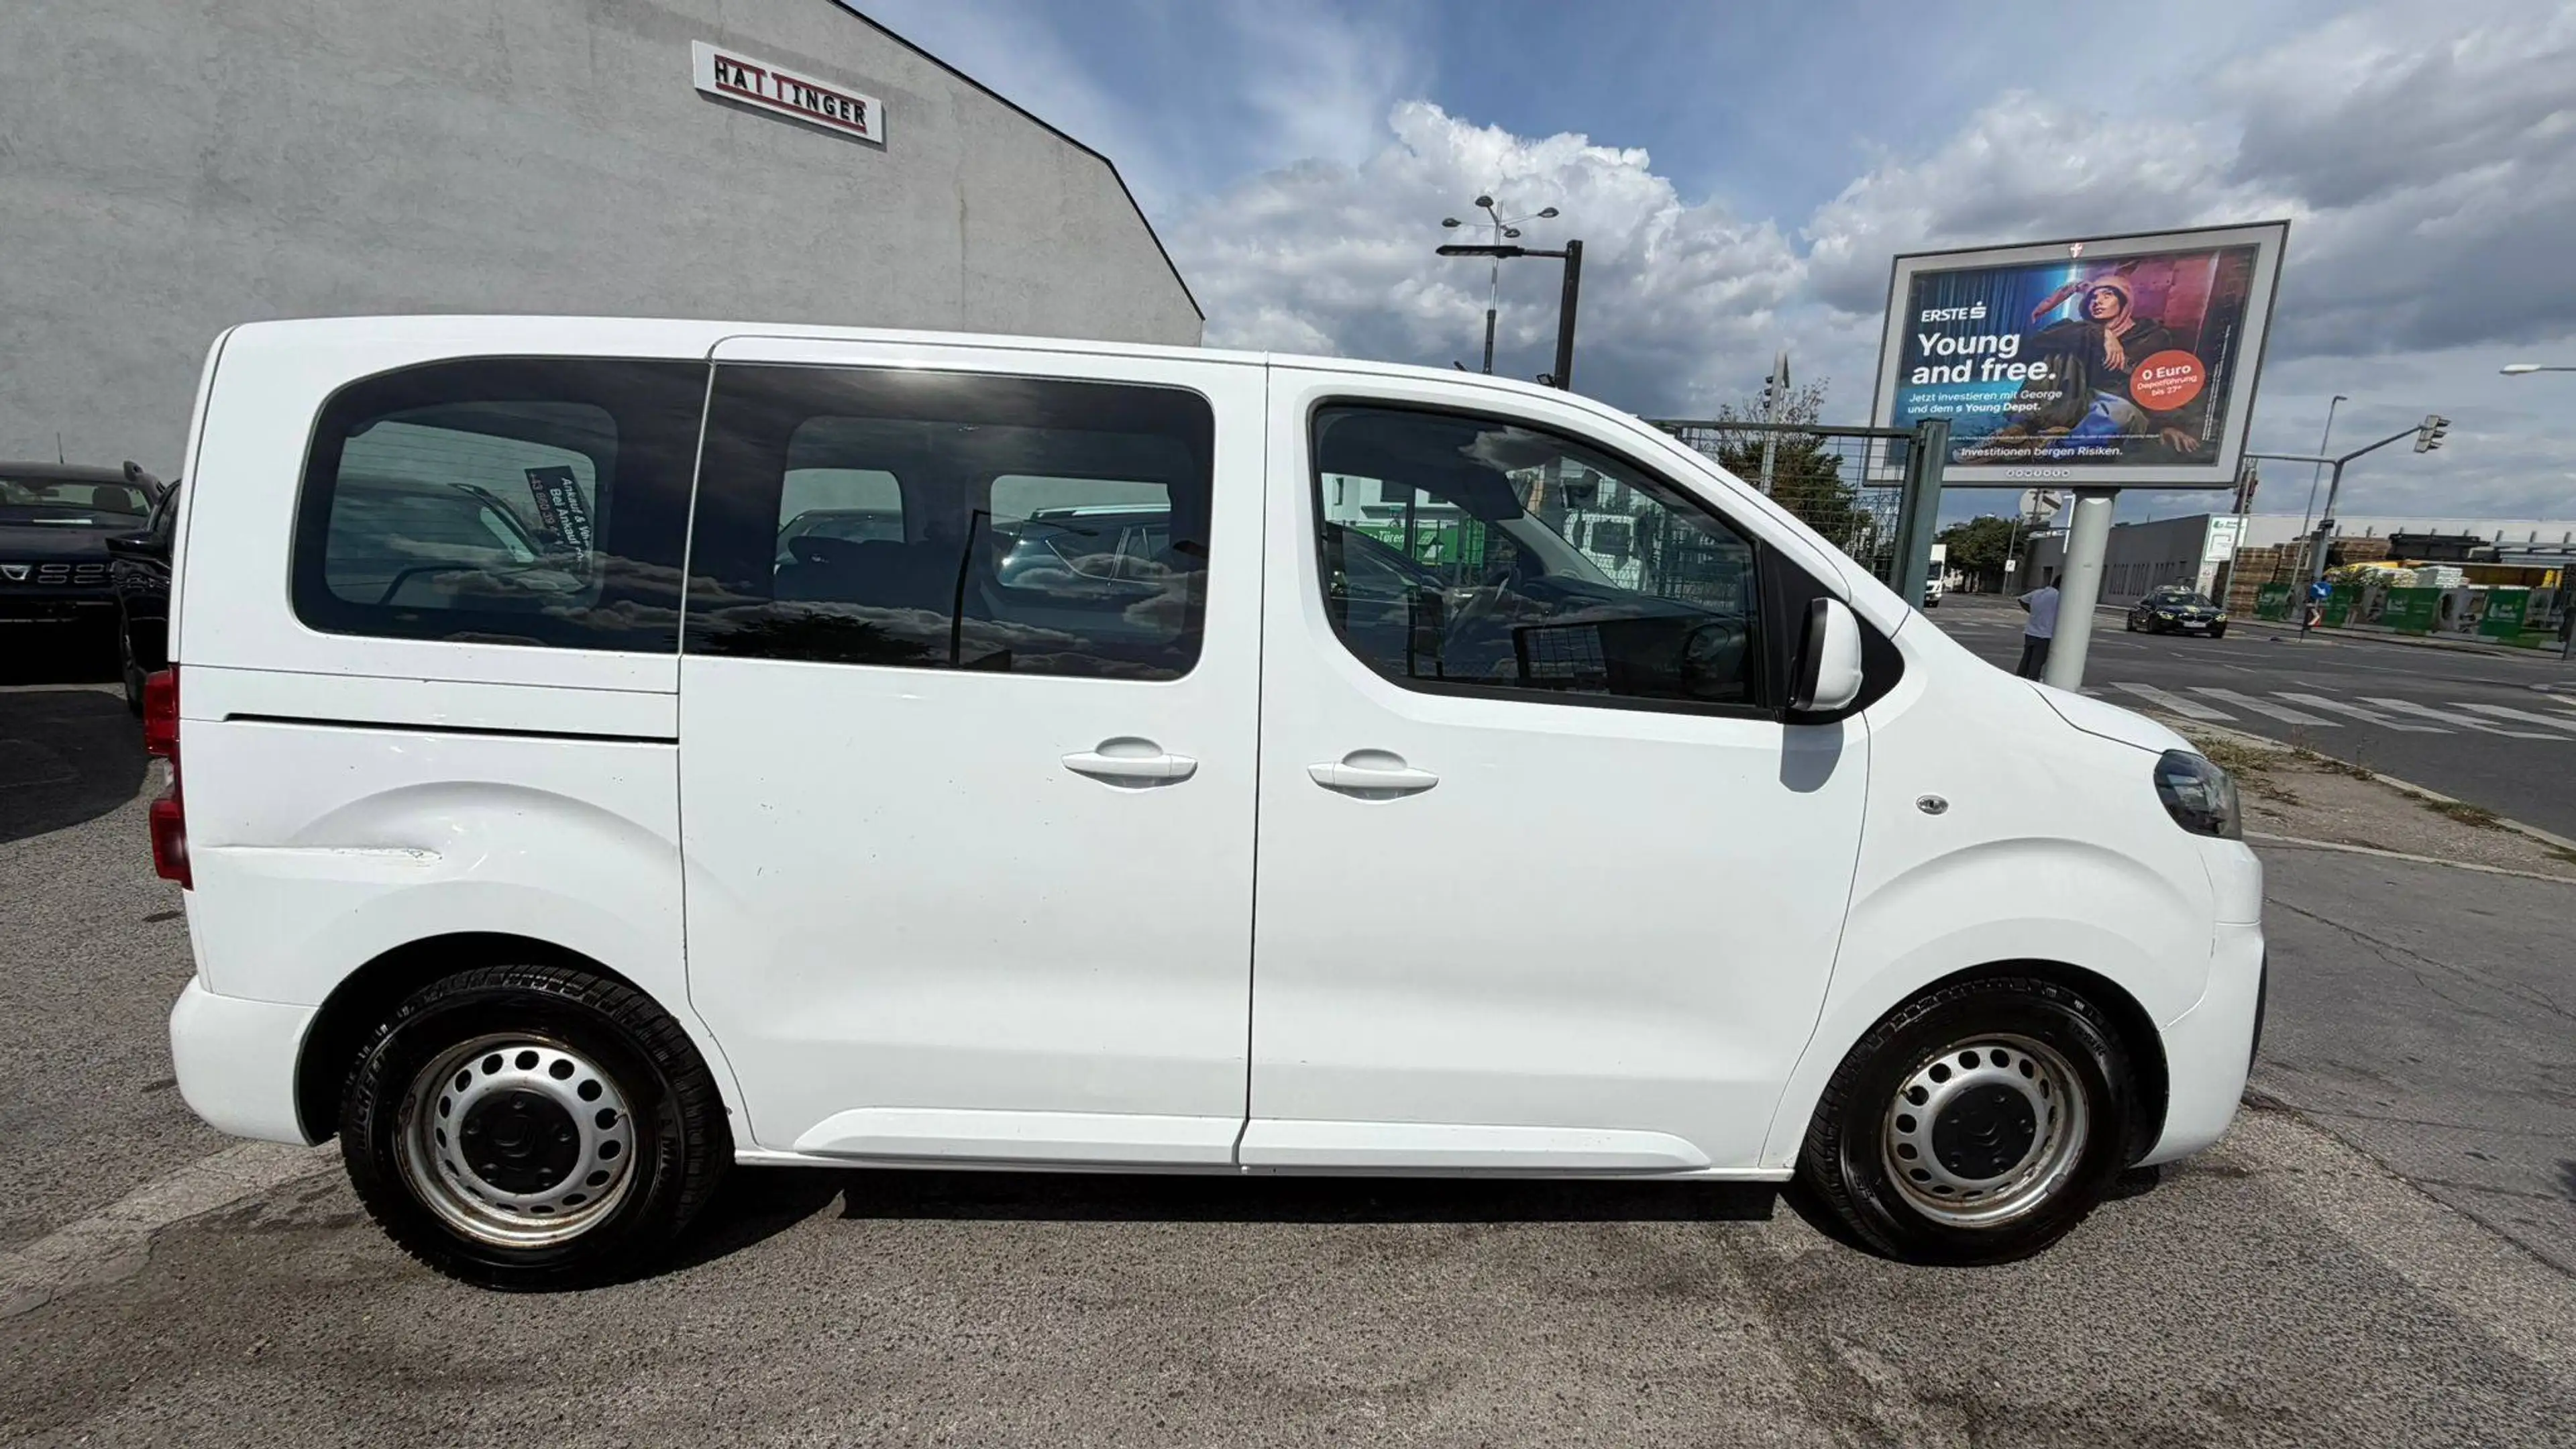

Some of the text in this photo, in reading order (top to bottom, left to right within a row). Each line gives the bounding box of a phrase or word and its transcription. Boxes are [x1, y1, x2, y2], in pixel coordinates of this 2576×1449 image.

[714, 60, 866, 125] HATTINGER
[1921, 307, 1968, 322] ERSTE
[1918, 332, 2021, 358] Young
[1912, 357, 2056, 384] and free.
[2142, 365, 2192, 380] 0 Euro
[1909, 389, 2063, 402] Jetzt investieren mit George
[1908, 405, 1927, 413] und
[1930, 404, 1953, 413] dem
[1966, 403, 2000, 414] Young
[2003, 402, 2041, 413] Depot.
[1962, 445, 2123, 459] Investitionen bergen Risiken.
